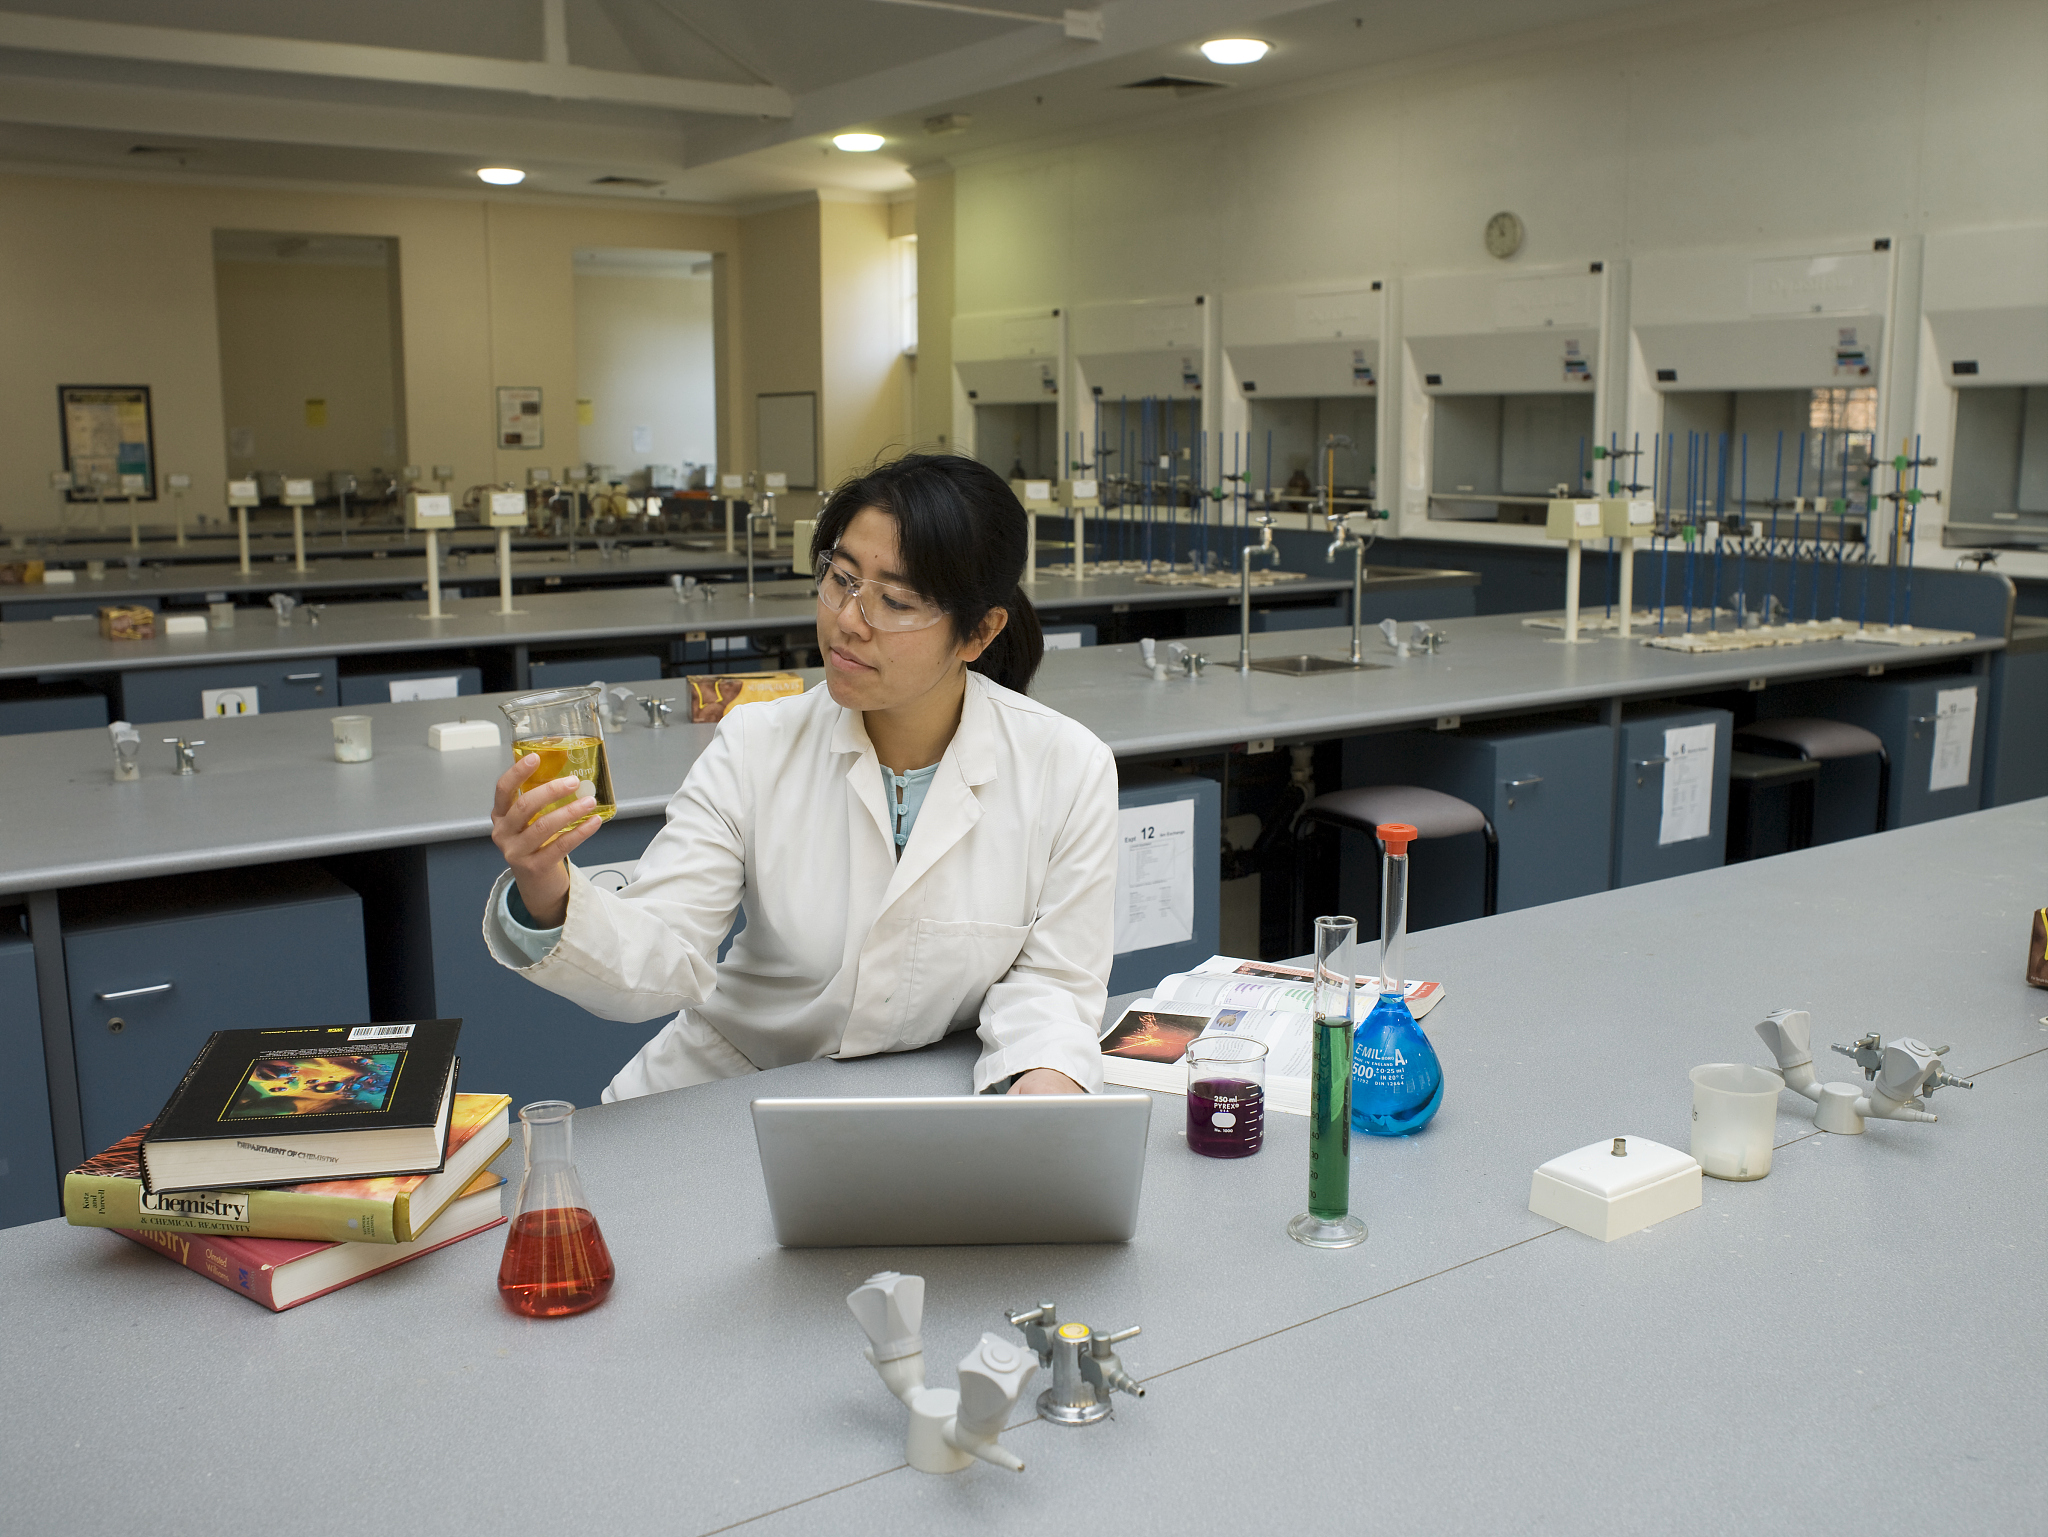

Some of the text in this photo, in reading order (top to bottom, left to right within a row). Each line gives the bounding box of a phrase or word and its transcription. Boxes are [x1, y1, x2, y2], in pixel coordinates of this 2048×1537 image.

[1140, 826, 1155, 840] 12
[1352, 1062, 1373, 1079] 500
[236, 1140, 339, 1164] DEPARTMENT OF CHEMISTRY
[82, 1192, 90, 1209] Kotz
[141, 1191, 245, 1221] Chemistry
[140, 1216, 251, 1233] & CHEMICAL REACTIVITY
[205, 1248, 228, 1268] Olmsted
[205, 1261, 230, 1282] Williams
